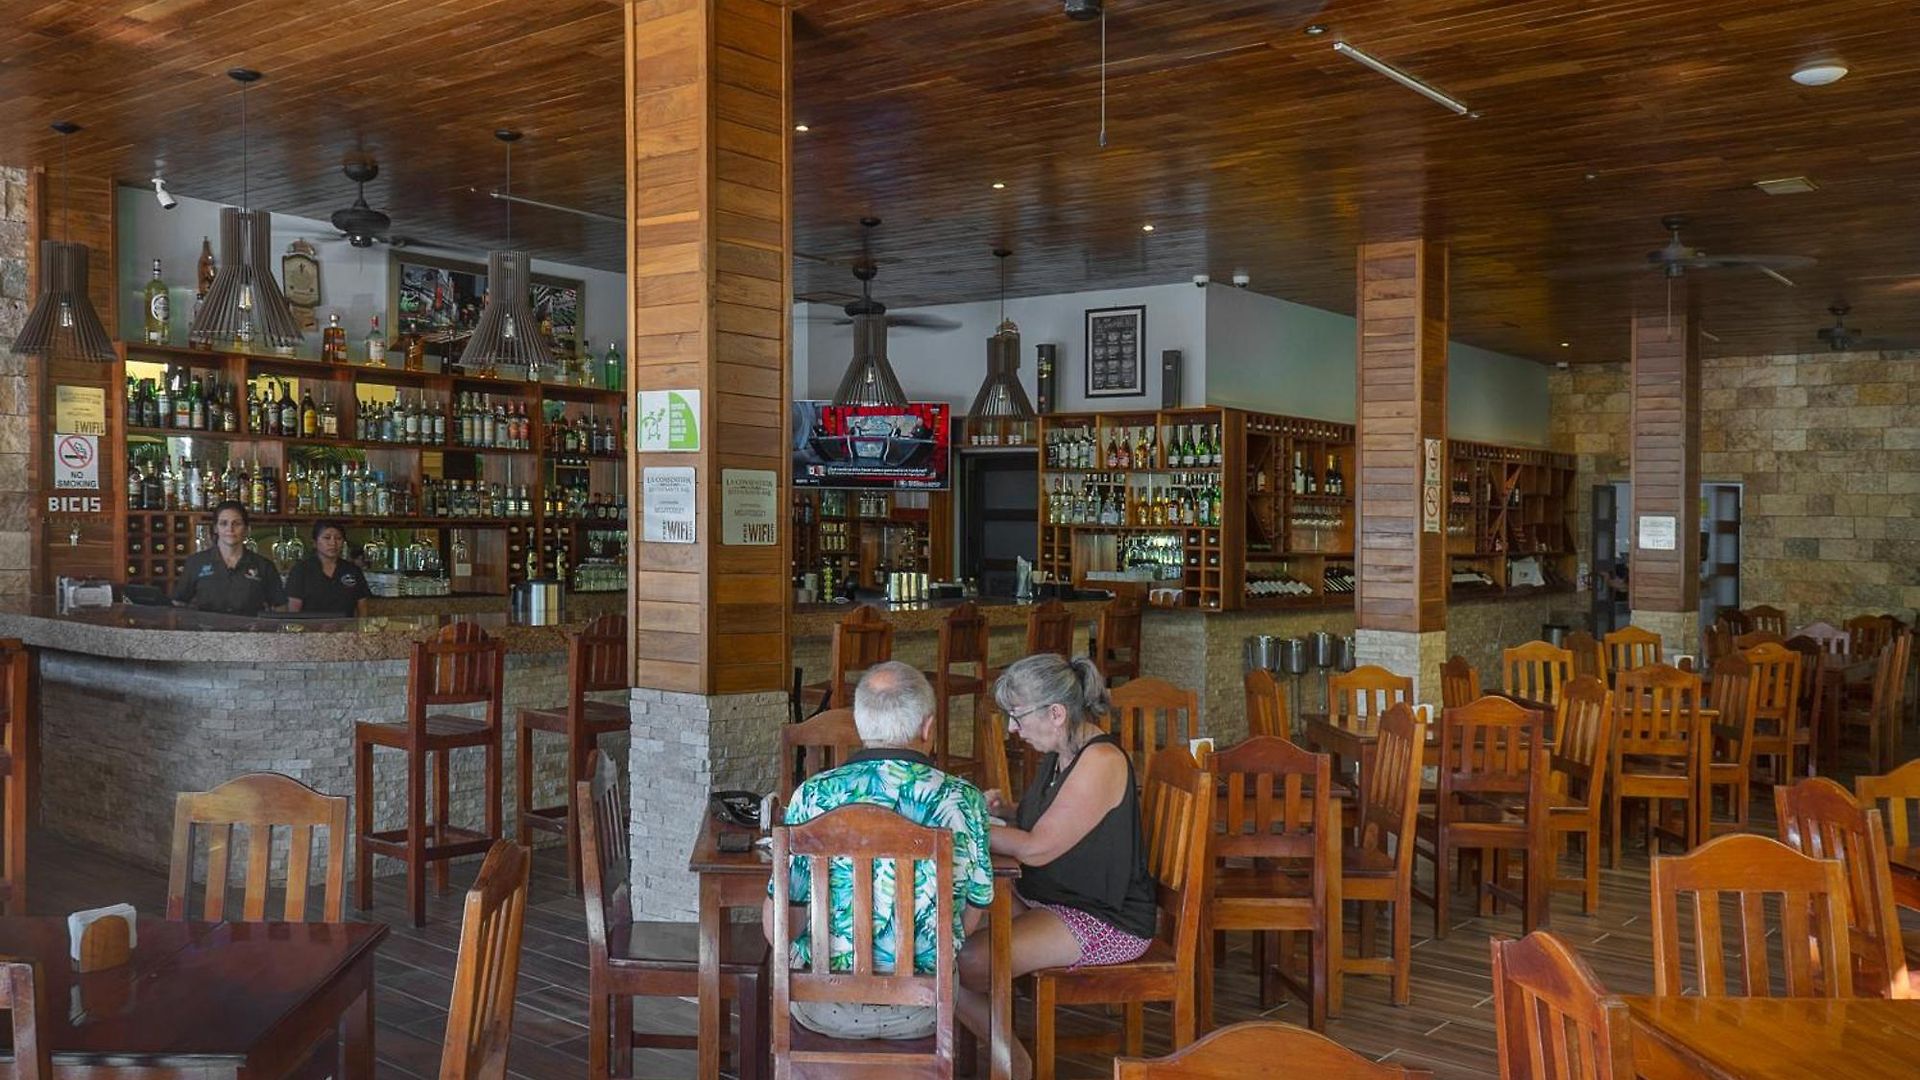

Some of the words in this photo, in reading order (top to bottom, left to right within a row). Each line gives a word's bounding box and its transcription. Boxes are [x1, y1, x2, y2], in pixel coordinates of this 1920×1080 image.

[48, 497, 101, 512] BICIS
[667, 521, 689, 541] WIFI
[748, 523, 770, 543] WIFI
